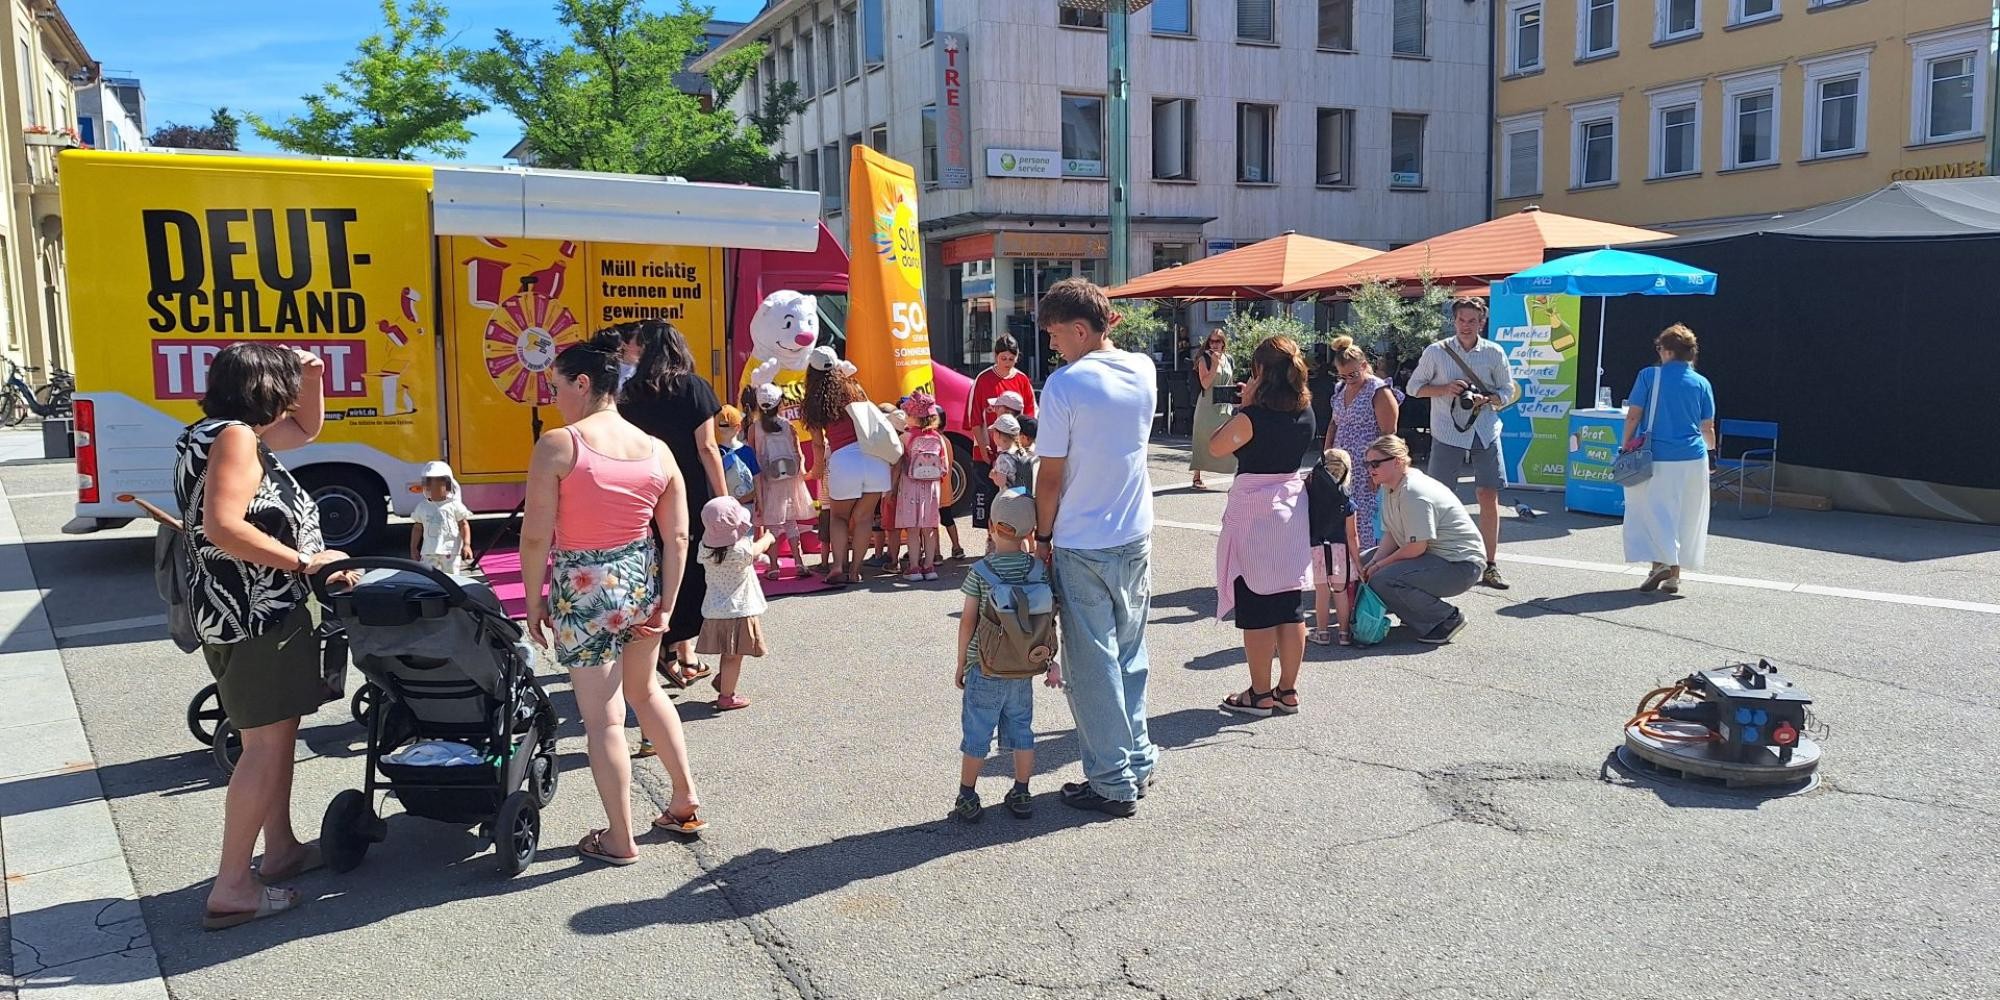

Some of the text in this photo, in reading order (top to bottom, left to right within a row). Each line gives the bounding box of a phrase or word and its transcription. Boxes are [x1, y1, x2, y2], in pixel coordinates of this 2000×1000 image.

[944, 48, 964, 165] TRESOR
[1019, 157, 1050, 165] persona
[1019, 165, 1046, 173] service
[142, 208, 371, 291] DEUT-
[601, 259, 696, 282] Müll richtig
[602, 282, 702, 299] trennen und
[147, 289, 366, 333] SCHLAND
[603, 303, 684, 321] gewinnen!
[891, 301, 925, 340] 50
[1503, 328, 1549, 339] Manches
[1516, 347, 1543, 357] sollte
[158, 345, 362, 394] TRT.
[1512, 367, 1554, 376] trennte
[1529, 386, 1556, 398] Wege
[1521, 403, 1563, 413] gehen.
[1582, 426, 1605, 440] Brot
[1588, 450, 1607, 460] mag
[1573, 463, 1615, 480] Vesperbo
